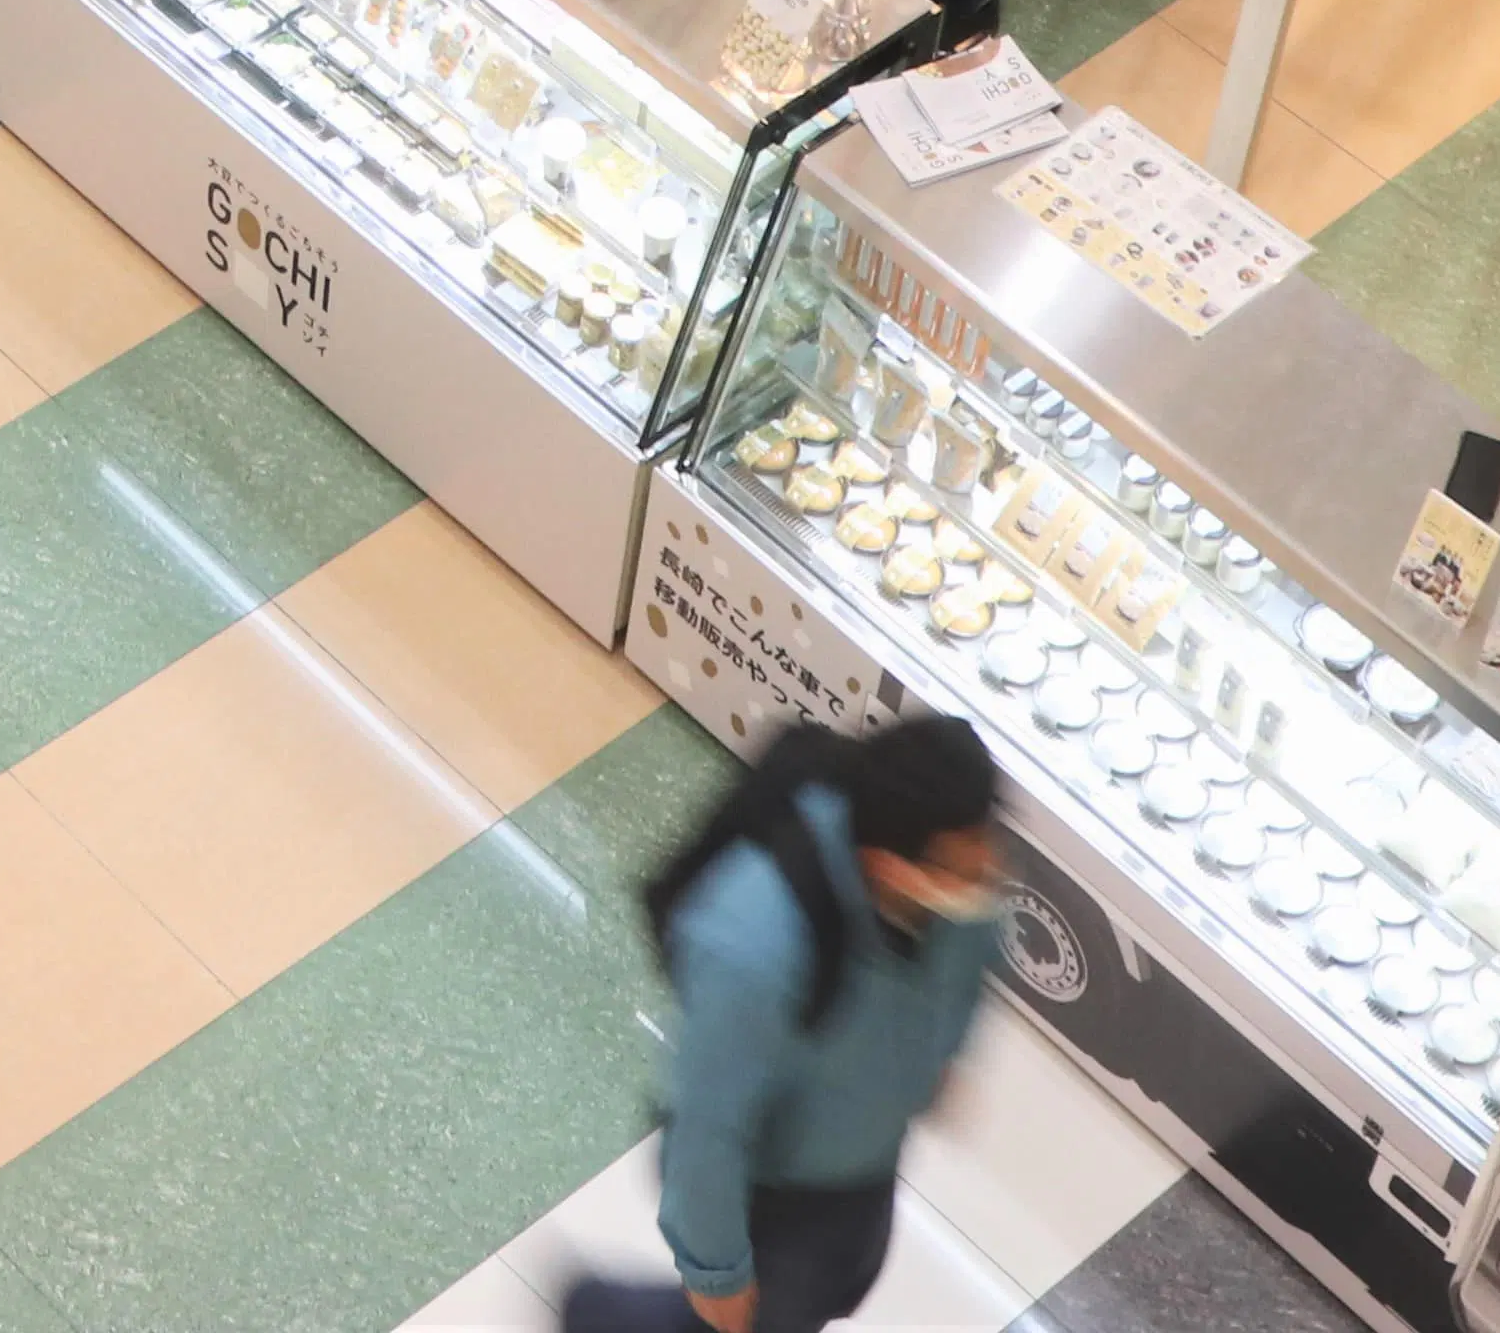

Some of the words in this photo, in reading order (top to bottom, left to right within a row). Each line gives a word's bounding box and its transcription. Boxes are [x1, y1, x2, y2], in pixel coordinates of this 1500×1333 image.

[207, 181, 331, 313] GOCHI
[653, 575, 831, 730] 移動販売やって
[658, 546, 845, 718] 長崎でこんな車で
